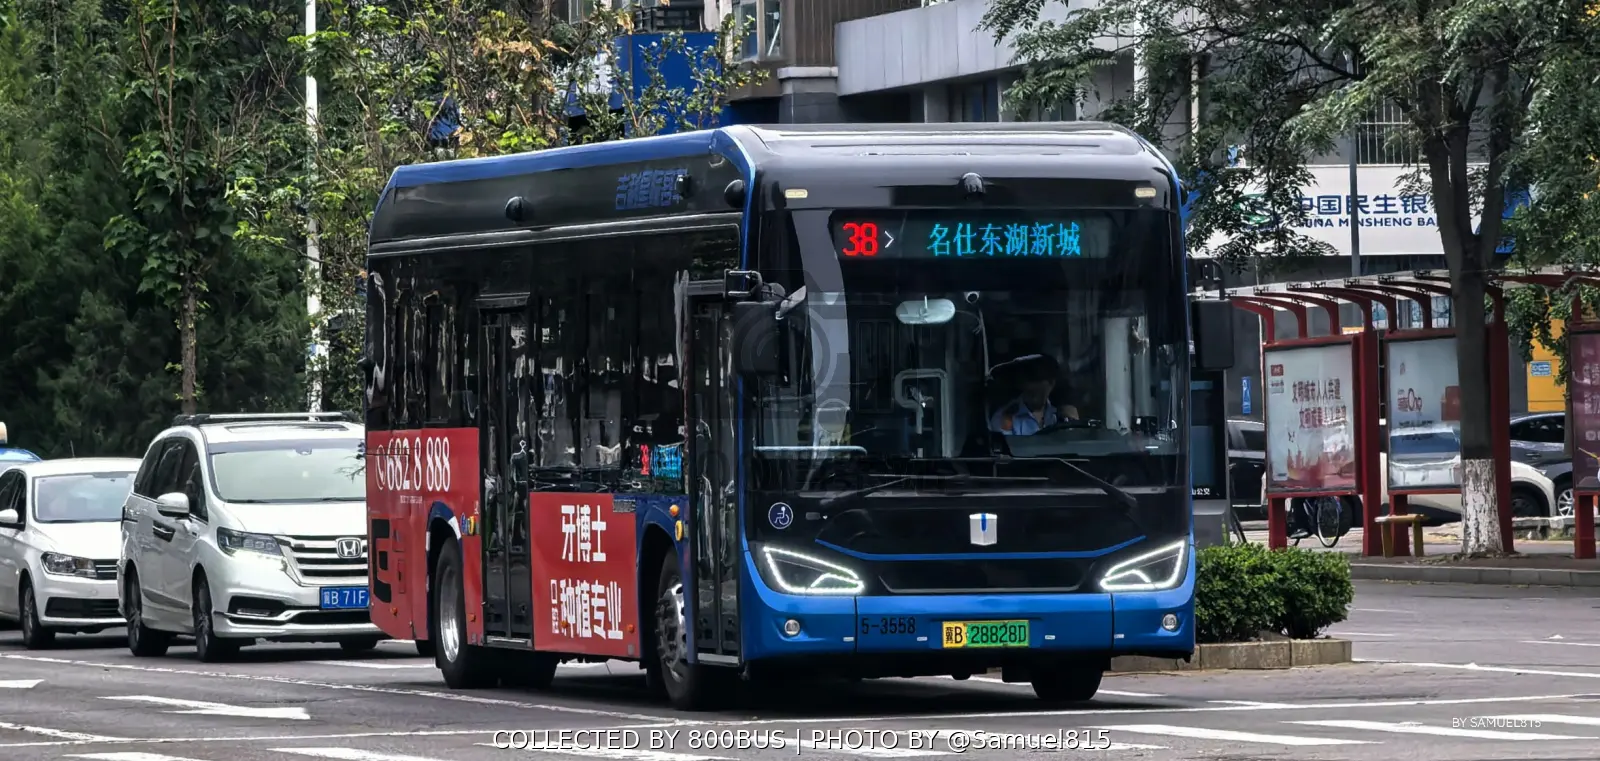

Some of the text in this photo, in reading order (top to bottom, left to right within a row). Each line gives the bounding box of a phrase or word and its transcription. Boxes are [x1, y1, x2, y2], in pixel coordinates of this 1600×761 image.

[842, 222, 878, 256] 38
[927, 222, 1081, 256] 名仕东湖新城
[1339, 217, 1412, 227] MNSHENG
[1417, 217, 1437, 226] BA
[561, 505, 606, 562] 牙博士
[560, 578, 624, 640] 种植专业
[861, 618, 916, 635] 5-3558
